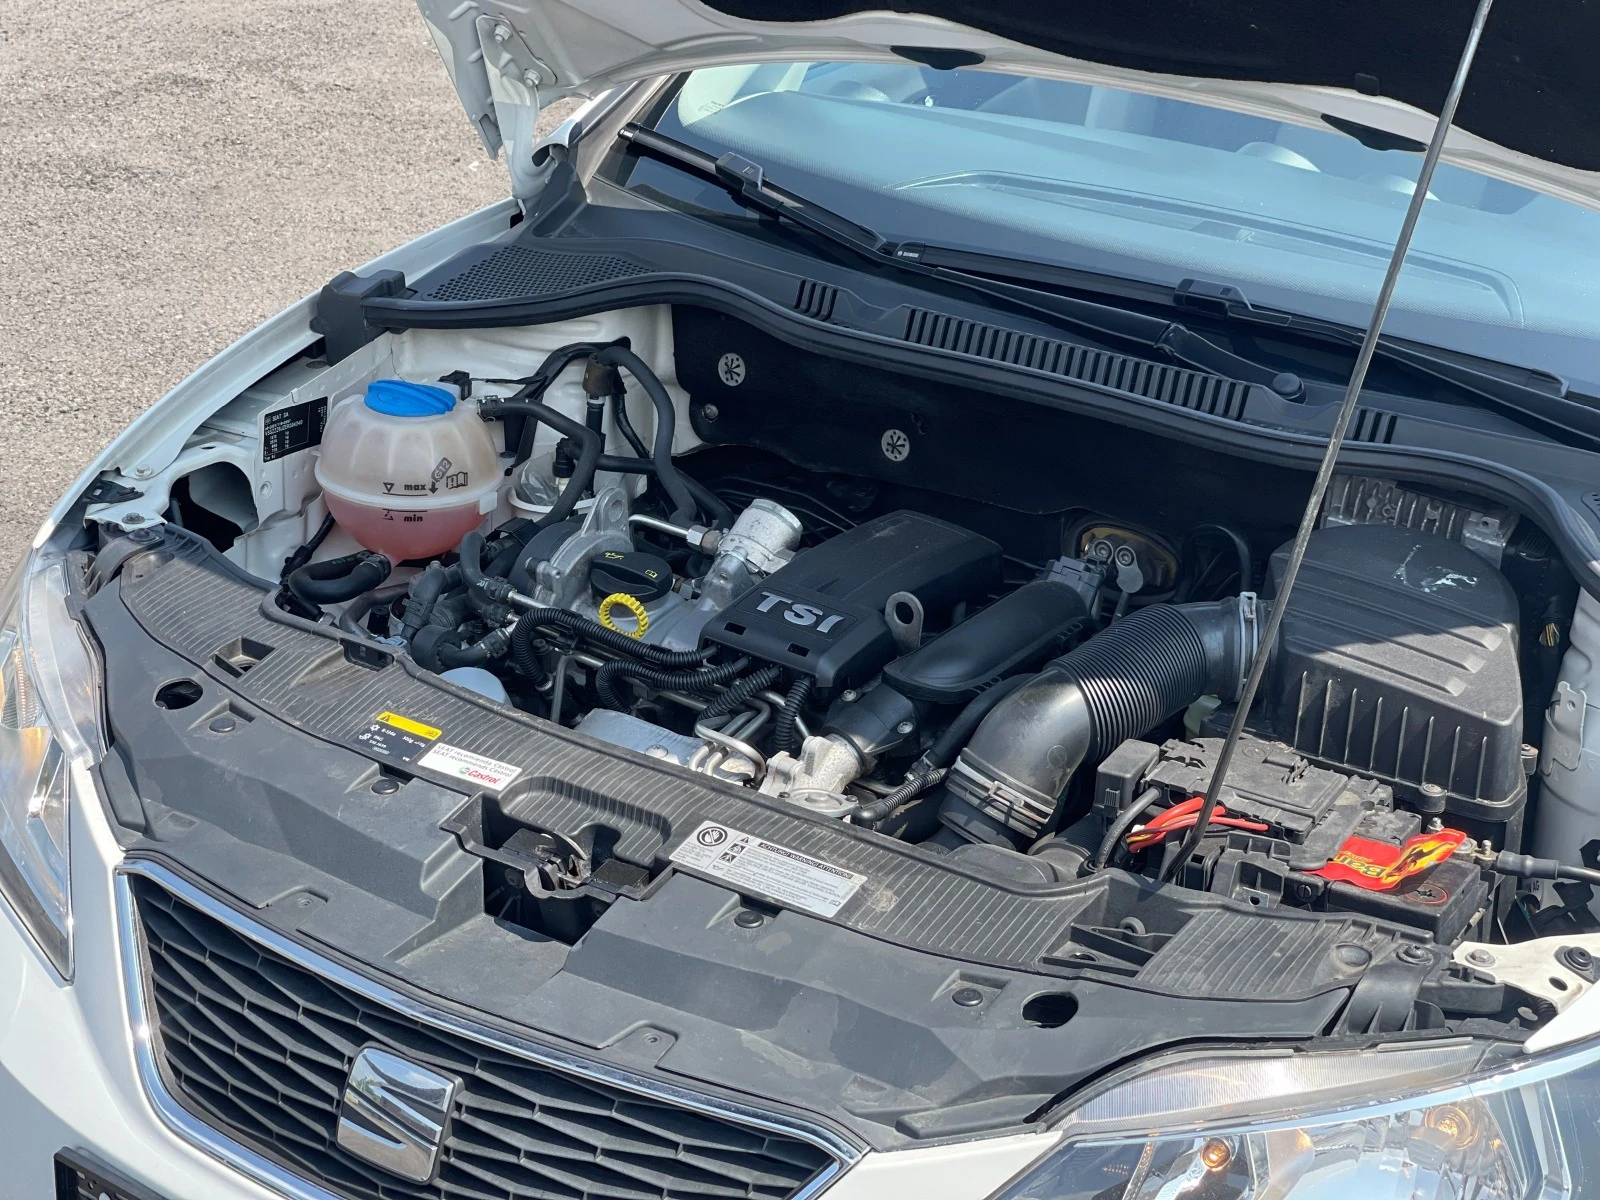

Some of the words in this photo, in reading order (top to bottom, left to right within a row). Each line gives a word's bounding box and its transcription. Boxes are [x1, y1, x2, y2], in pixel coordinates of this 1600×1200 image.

[435, 460, 451, 480] G12
[404, 483, 427, 491] max
[404, 514, 423, 523] min
[756, 591, 844, 633] TSI
[432, 748, 449, 758] SEAT
[448, 754, 488, 771] recommends
[488, 766, 513, 778] Castrol
[437, 744, 455, 753] SEAT
[454, 749, 492, 766] recomienda
[493, 762, 518, 774] Castrol
[467, 769, 502, 785] Castrol
[789, 853, 819, 868] WARNING!
